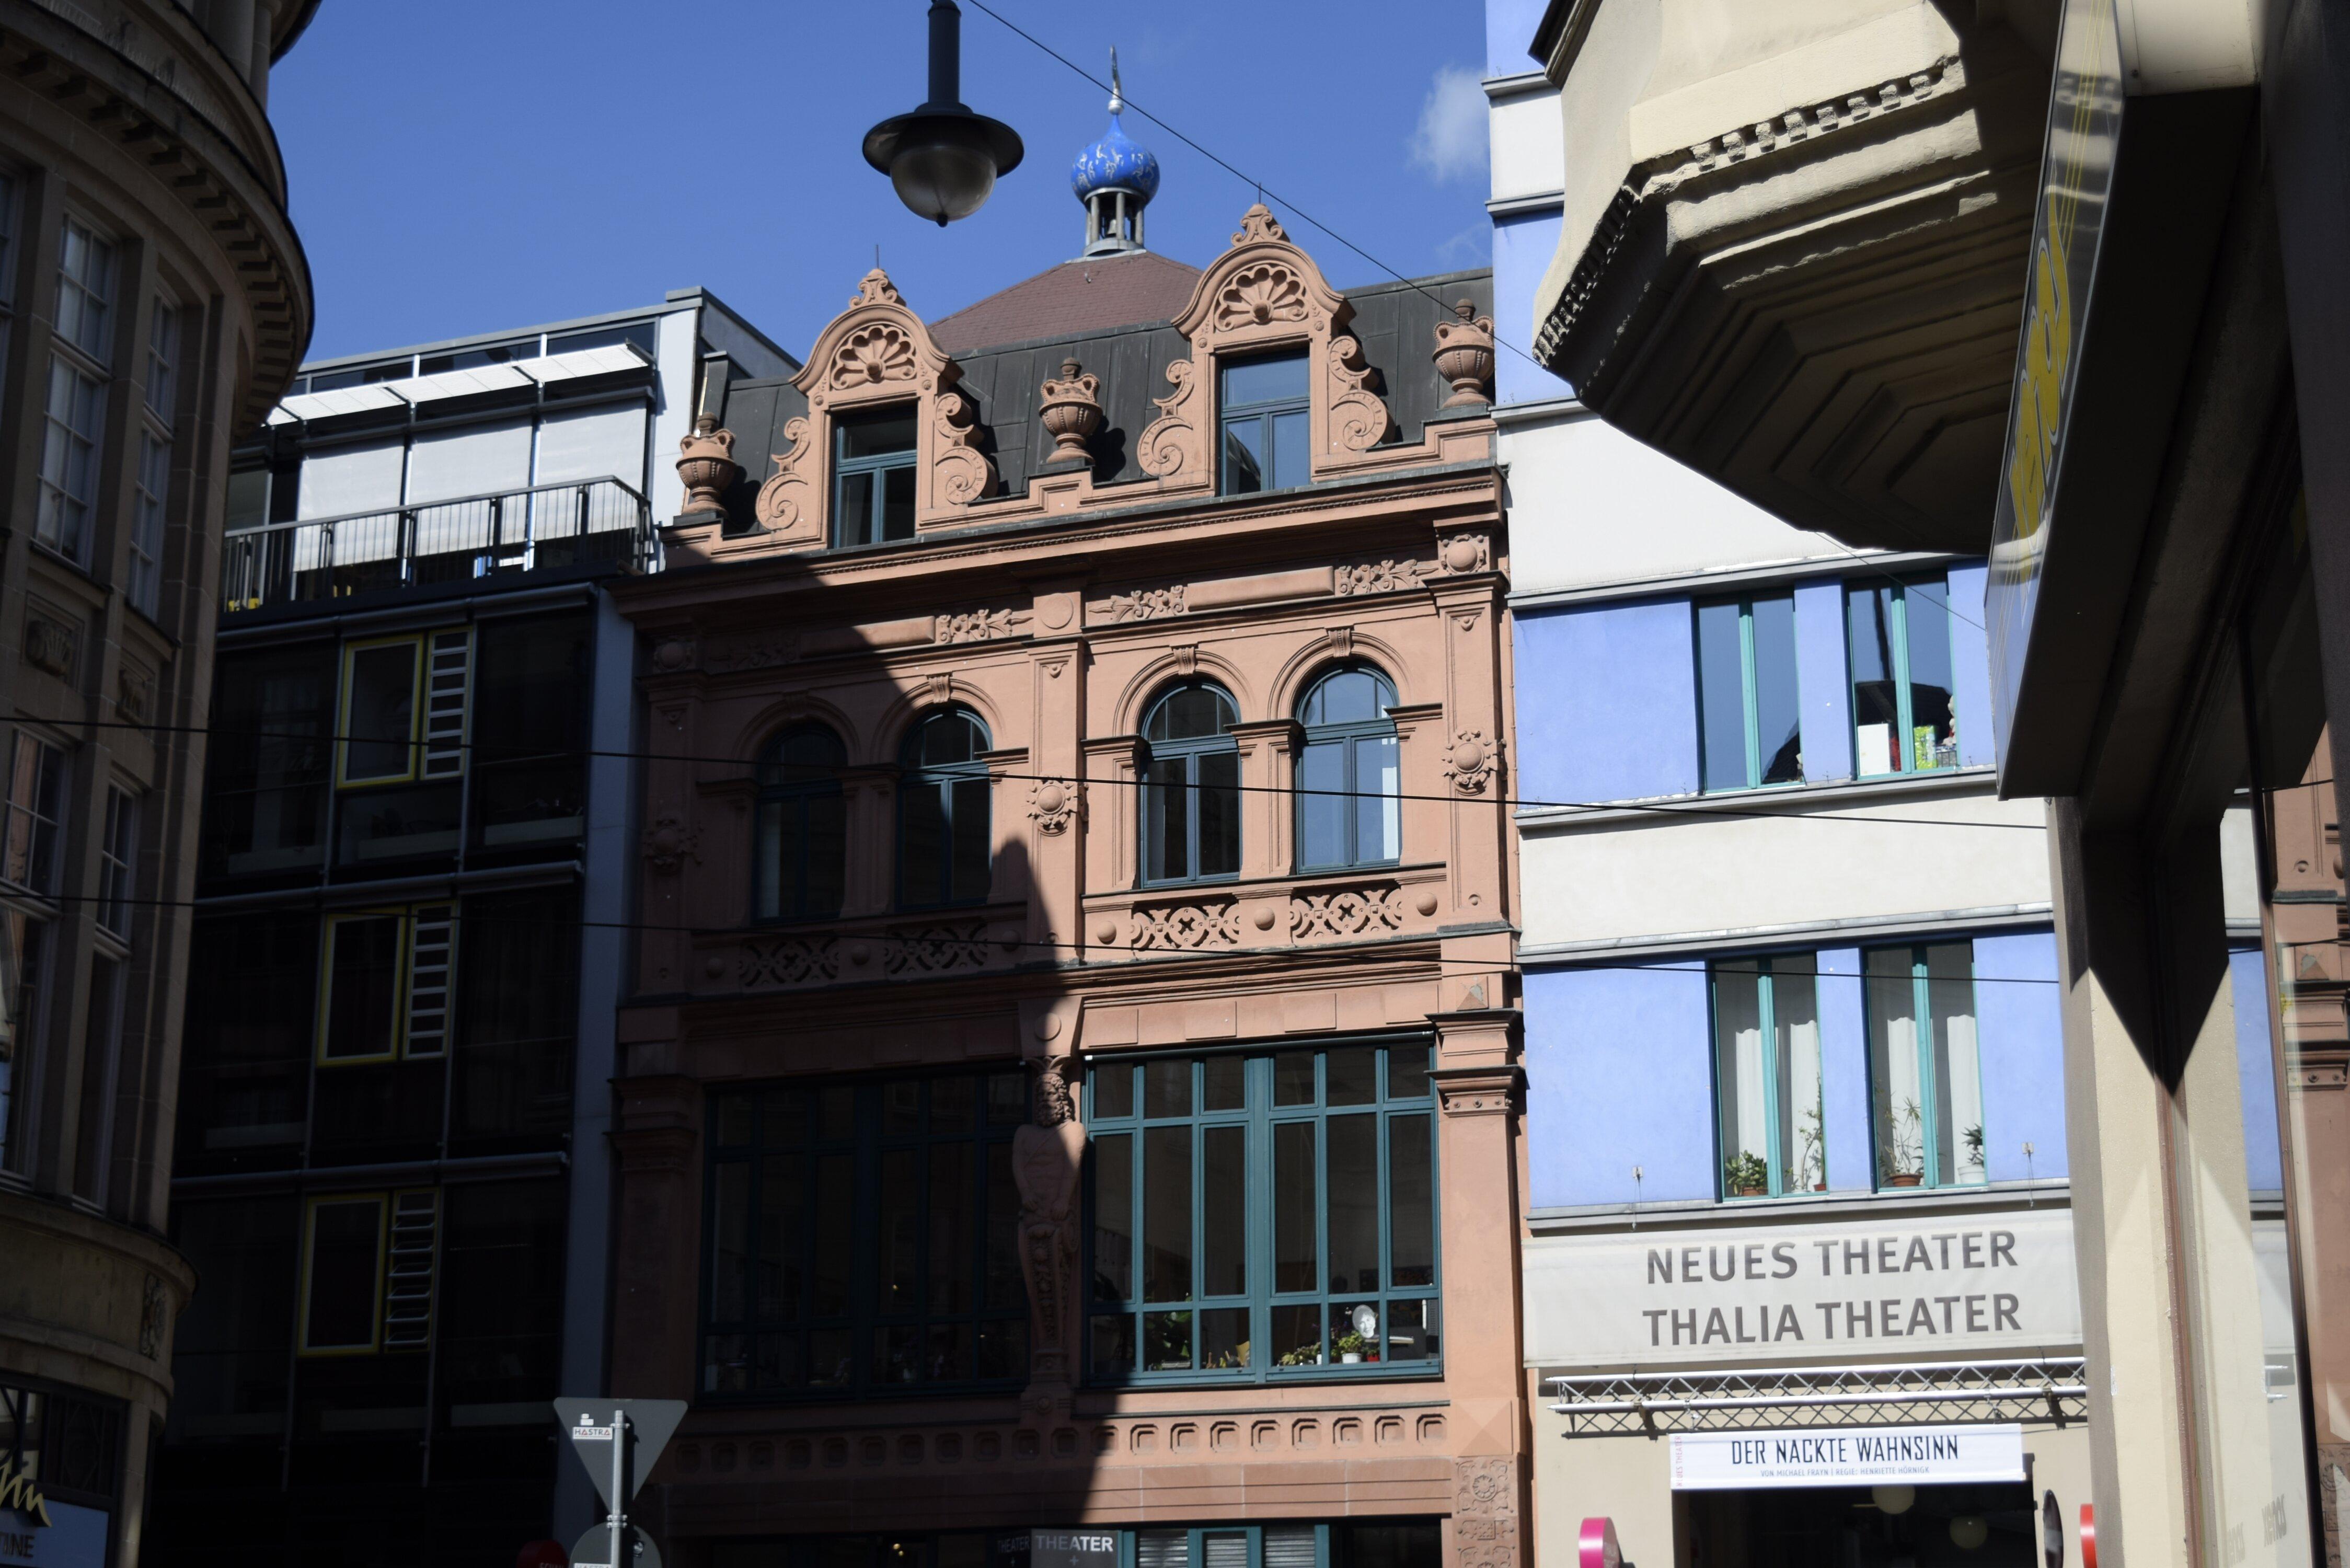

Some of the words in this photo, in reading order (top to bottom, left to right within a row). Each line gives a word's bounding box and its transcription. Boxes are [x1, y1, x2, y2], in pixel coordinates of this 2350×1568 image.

[1646, 1242, 1798, 1284] NEUES
[1813, 1229, 2019, 1277] THEATER
[1642, 1304, 1804, 1346] THALIA
[1815, 1293, 2022, 1339] THEATER
[1675, 1435, 1683, 1464] THEATER
[1732, 1440, 1766, 1464] DER
[1776, 1438, 1847, 1464] NACKTE
[1856, 1435, 1959, 1462] WAHNSINN
[1898, 1465, 1930, 1473] HÖRNIGK
[996, 1536, 1030, 1553] THEATER
[1035, 1535, 1113, 1552] THEATER
